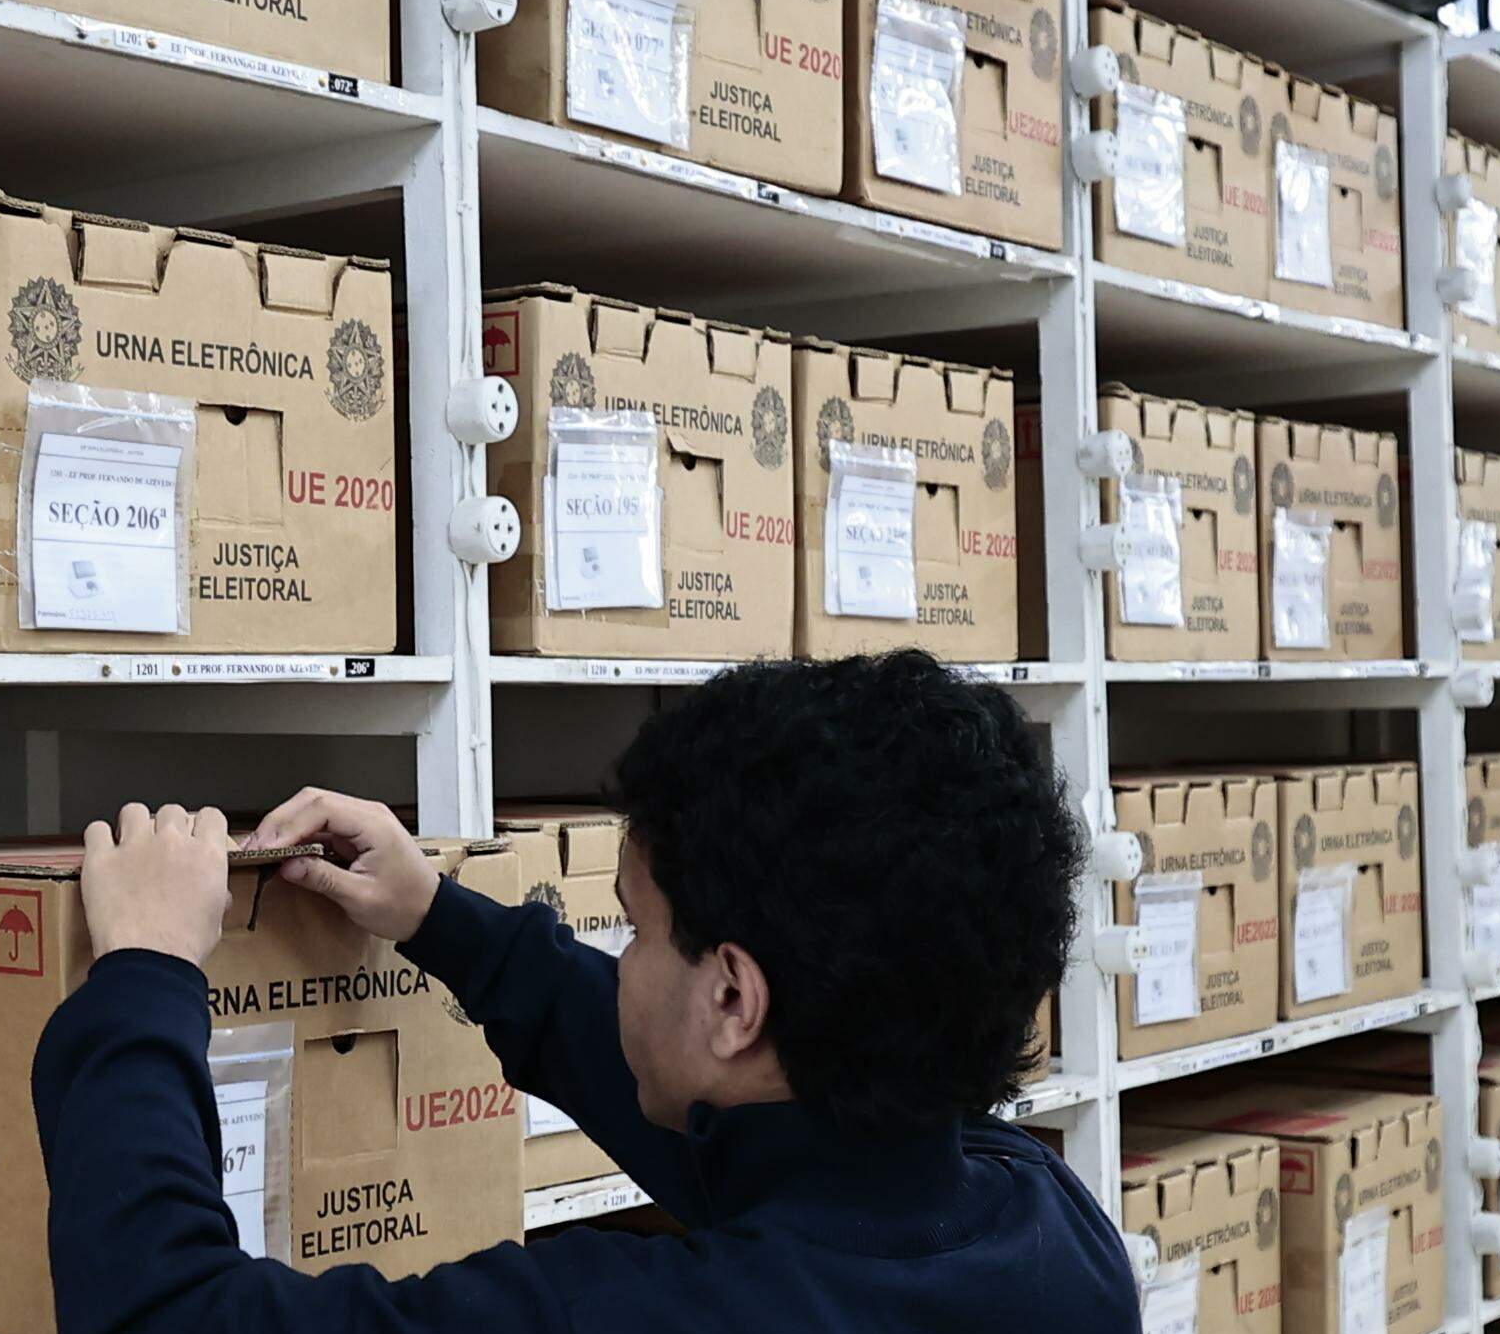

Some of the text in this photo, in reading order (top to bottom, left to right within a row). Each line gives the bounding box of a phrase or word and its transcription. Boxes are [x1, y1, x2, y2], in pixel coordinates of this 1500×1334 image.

[764, 32, 841, 81] UE 2020
[709, 79, 772, 115] JUSTIÇA
[700, 106, 781, 142] ELEITORAL
[96, 331, 313, 380] URNA ELETRÔNICA
[652, 402, 742, 436] ELETRÔNICA
[288, 470, 394, 512] UE 2020
[49, 501, 166, 530] SEÇÃO 206ª
[727, 511, 794, 546] UE 2020
[1193, 847, 1246, 870] ELETRÔNICA
[1236, 917, 1277, 946] UE2022
[204, 966, 430, 1017] RNA ELETRÔNICA
[1201, 989, 1245, 1012] ELEITORAL
[405, 1083, 516, 1133] UE2022
